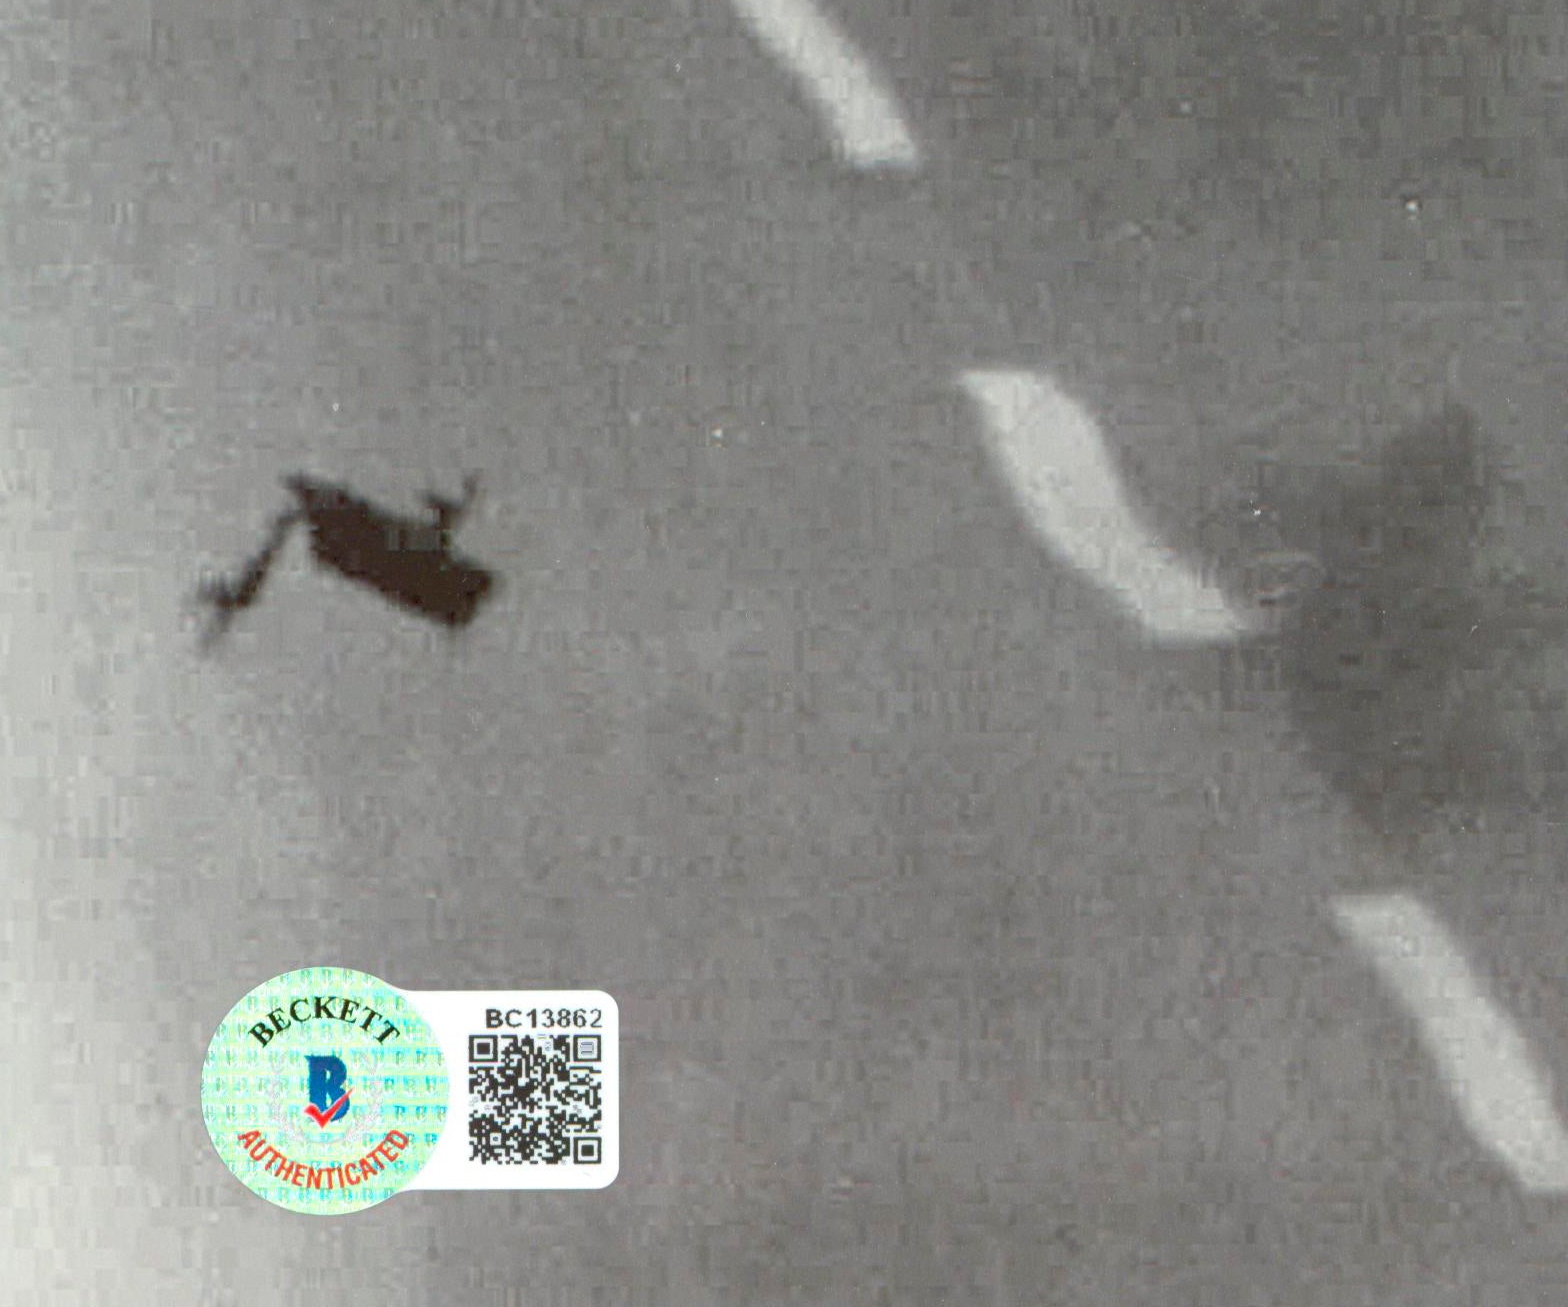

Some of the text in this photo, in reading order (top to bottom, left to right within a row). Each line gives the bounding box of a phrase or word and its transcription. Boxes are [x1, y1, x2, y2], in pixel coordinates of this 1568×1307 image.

[248, 995, 400, 1048] BECKETT
[485, 1007, 603, 1029] BC13862
[237, 1128, 410, 1190] AUTHENTICATED
